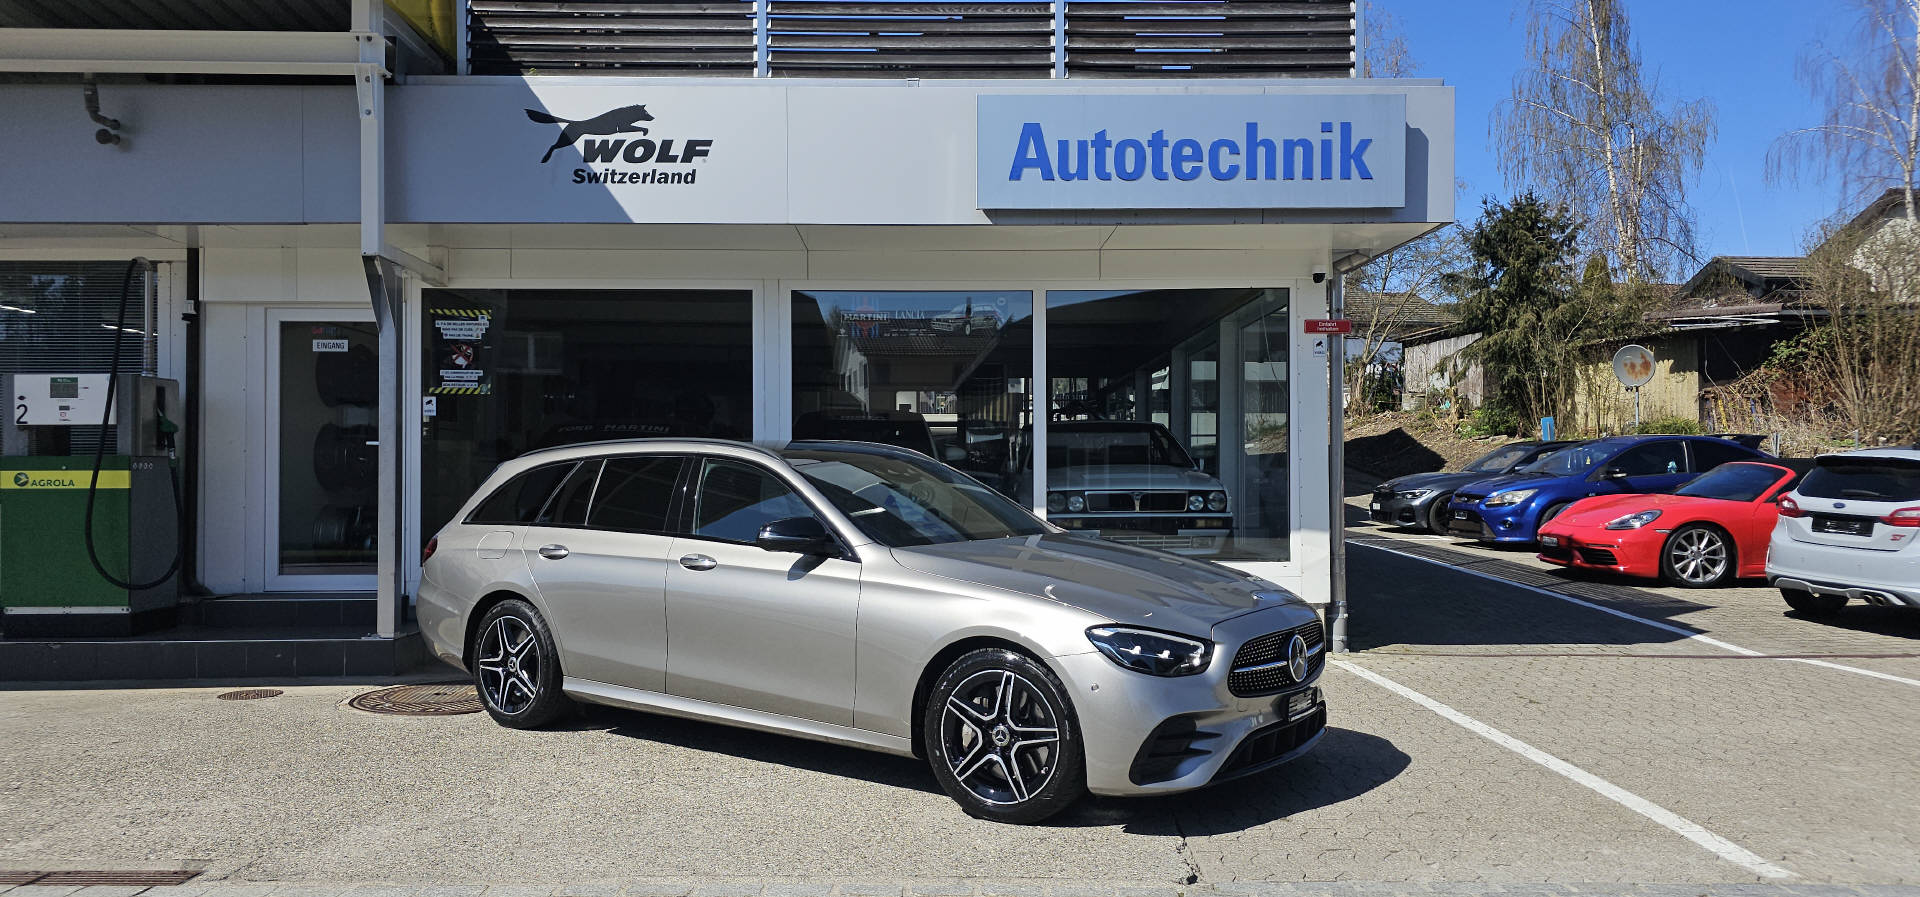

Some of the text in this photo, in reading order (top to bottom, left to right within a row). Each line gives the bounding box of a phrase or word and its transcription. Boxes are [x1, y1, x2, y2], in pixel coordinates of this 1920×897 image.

[583, 138, 713, 164] WOLF
[1008, 122, 1374, 182] Autotechnik
[572, 168, 697, 184] Switzerland
[843, 313, 888, 322] MARTINI
[895, 309, 925, 319] LANCIA
[316, 342, 345, 350] EINGANG
[16, 403, 28, 424] 2
[602, 424, 671, 433] MARTINI
[31, 479, 75, 487] AGROLA
